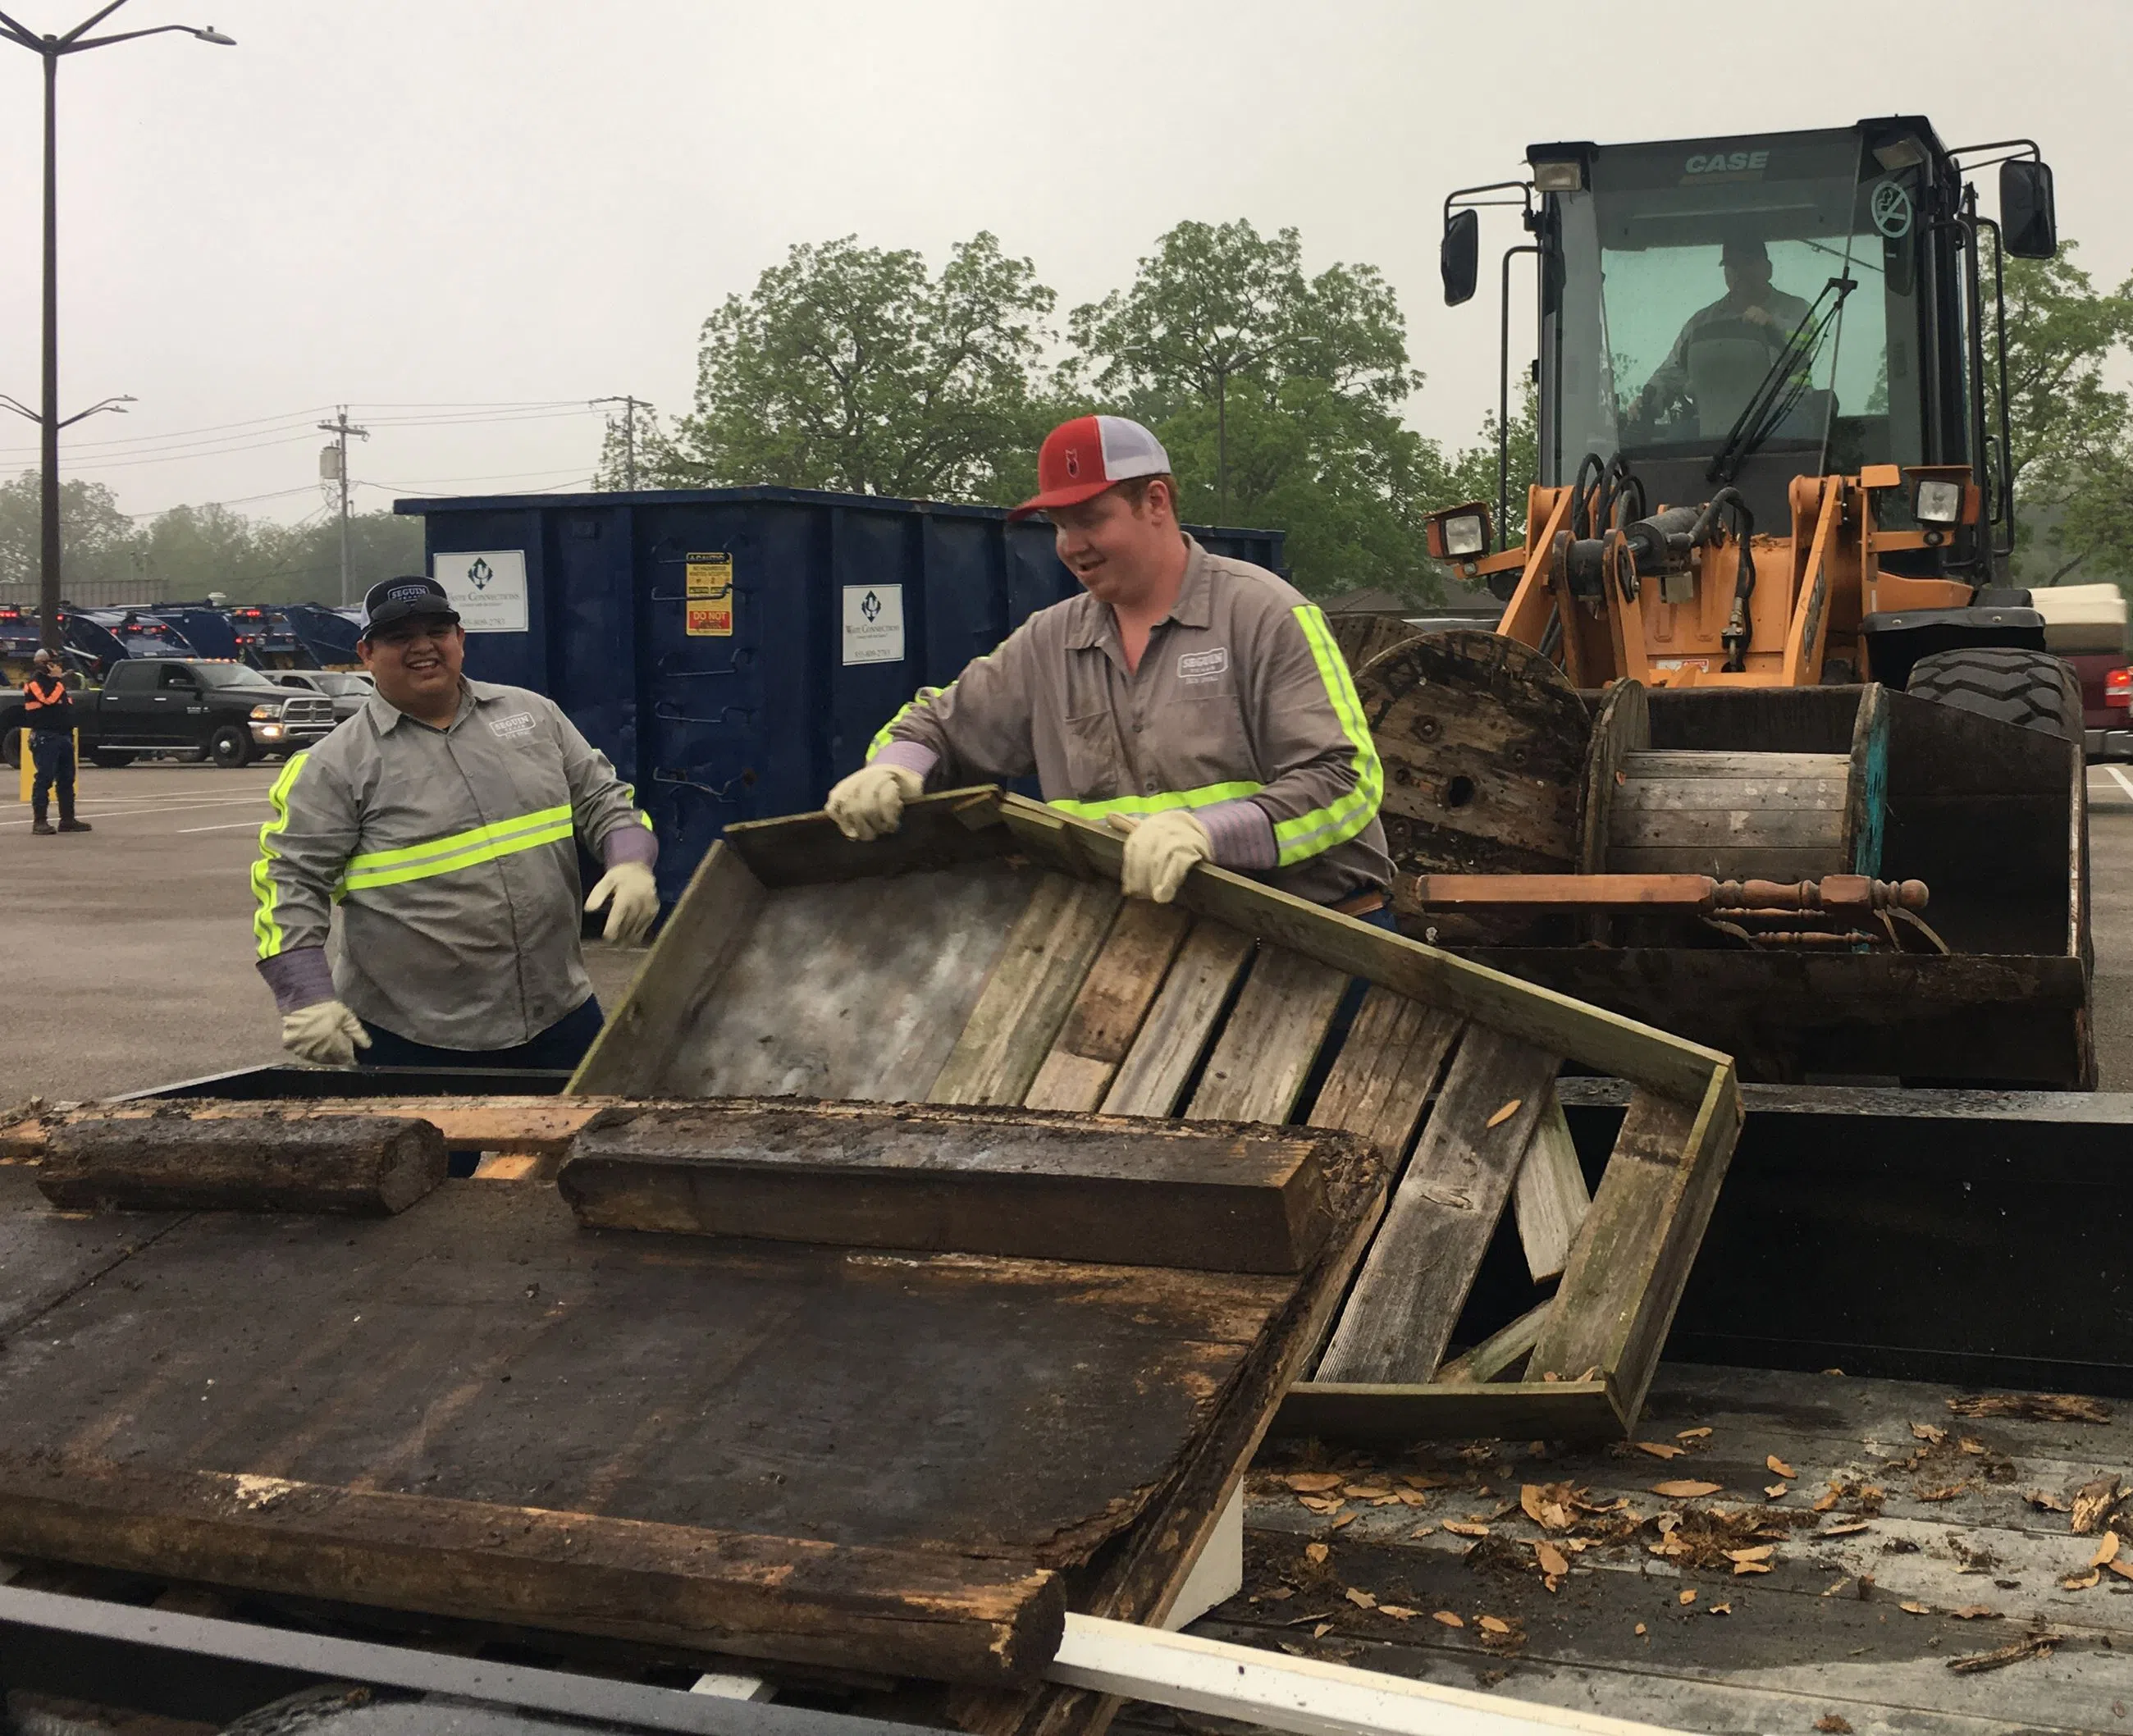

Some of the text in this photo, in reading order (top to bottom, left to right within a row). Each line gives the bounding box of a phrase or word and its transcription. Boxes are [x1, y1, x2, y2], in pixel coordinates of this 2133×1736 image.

[1685, 151, 1770, 173] CASE
[391, 587, 427, 599] SEGUIN
[693, 611, 727, 620] DO NOT
[495, 715, 529, 730] SEGUIN
